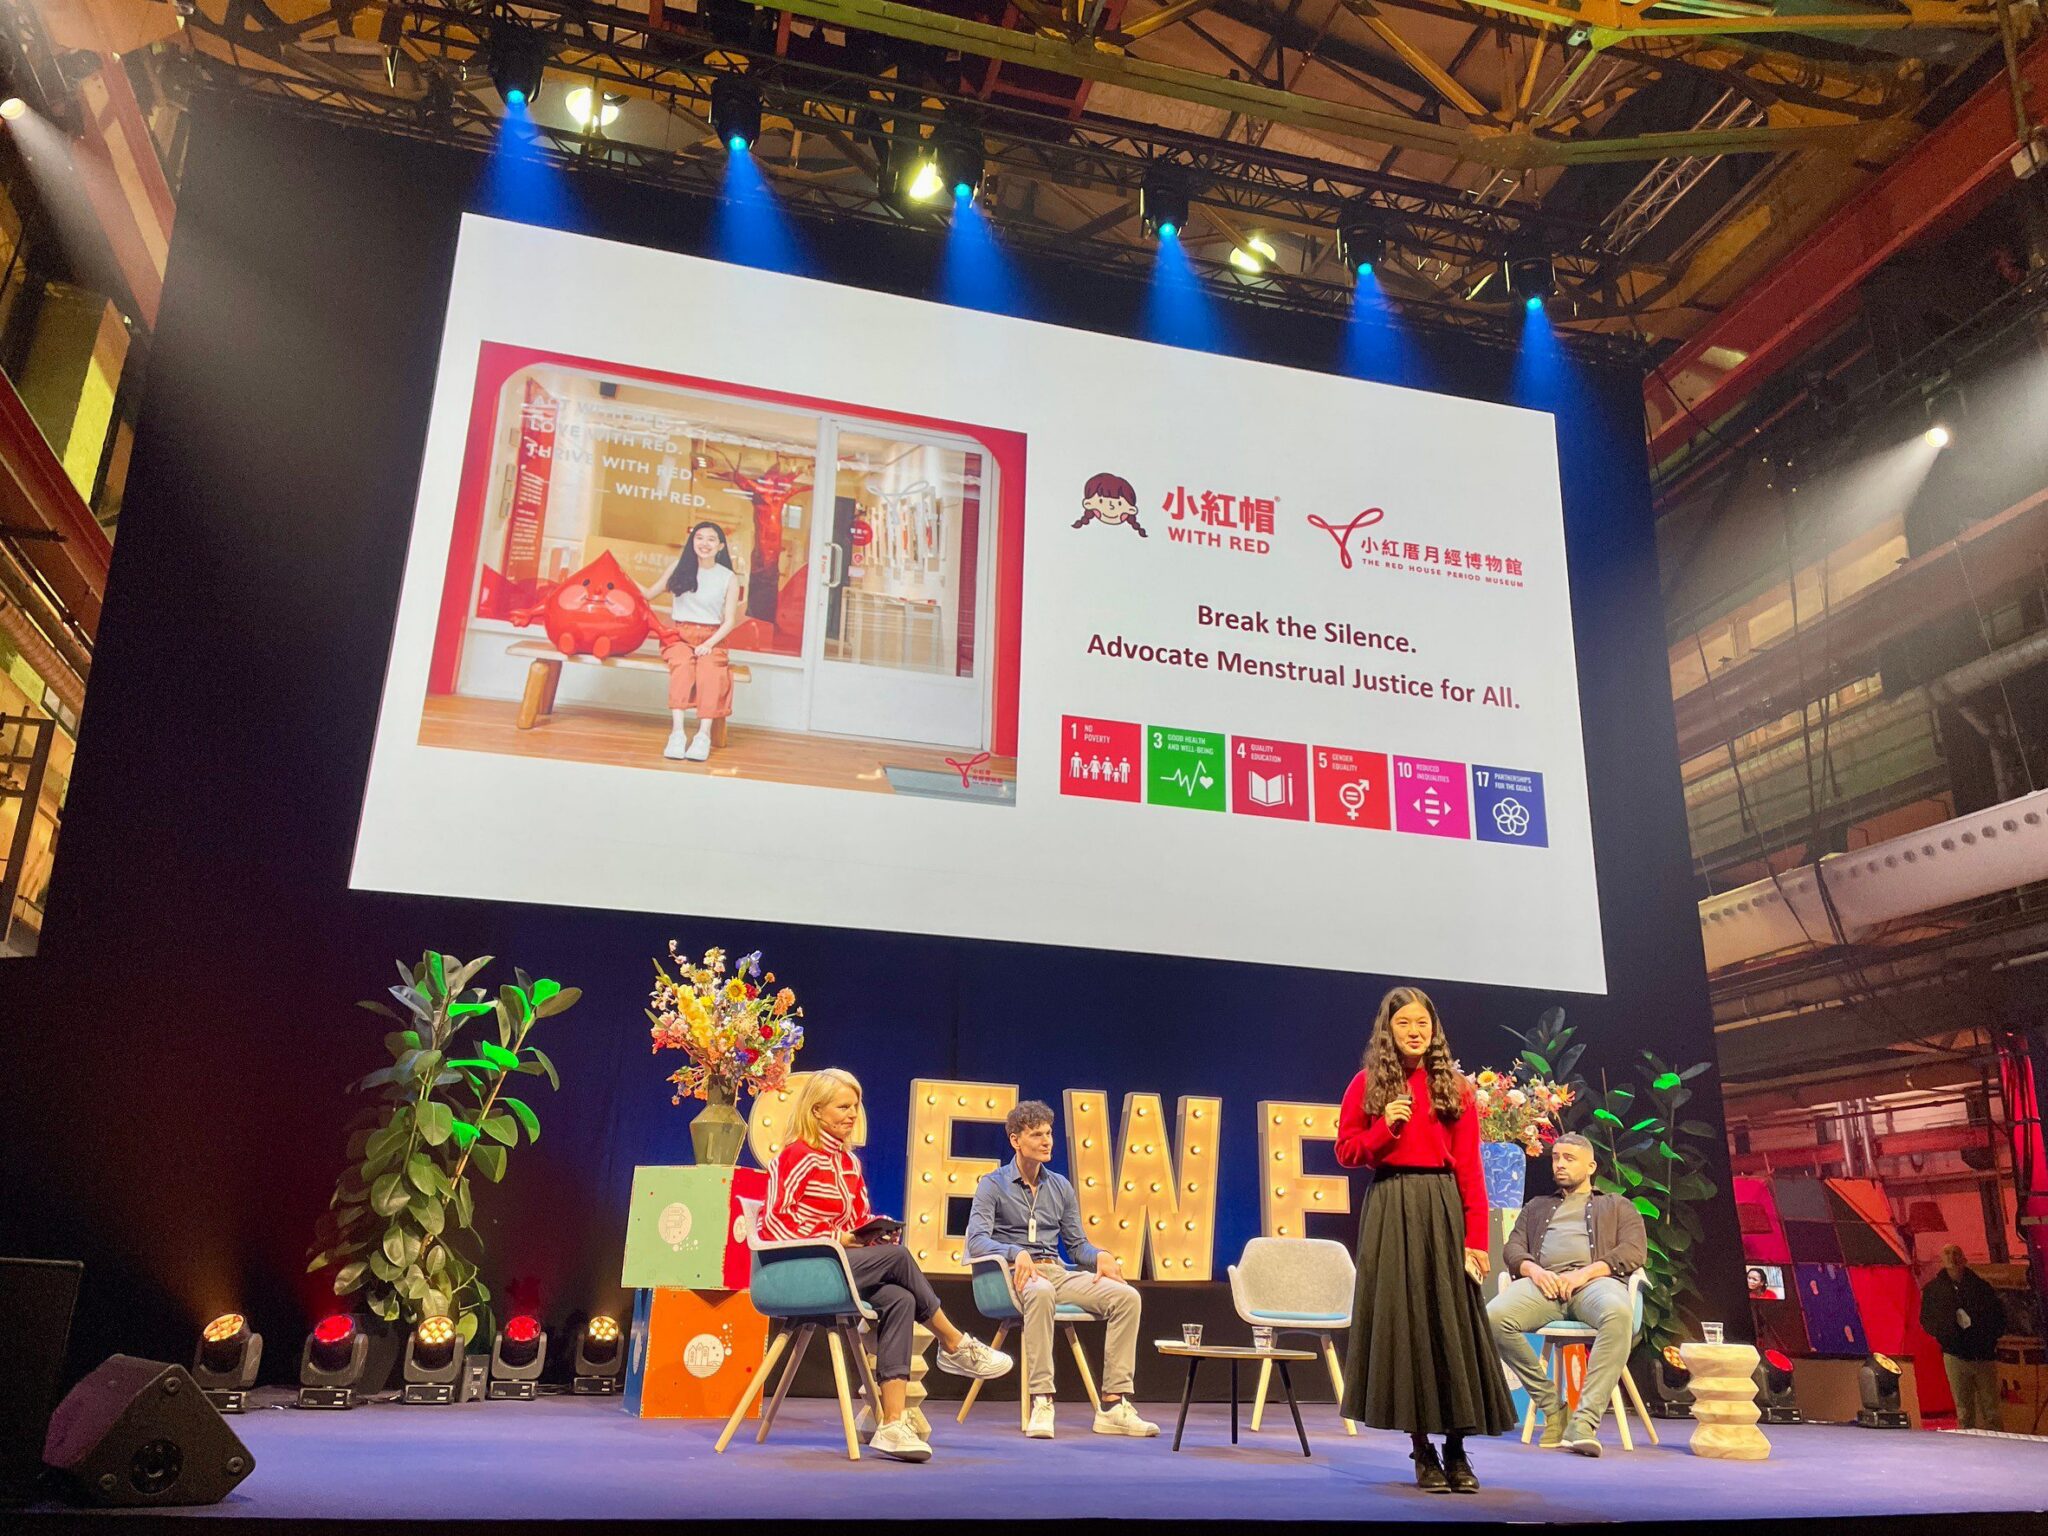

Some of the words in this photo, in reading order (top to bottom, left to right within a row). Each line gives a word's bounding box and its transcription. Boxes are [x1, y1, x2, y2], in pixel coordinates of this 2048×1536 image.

[602, 455, 650, 474] WITH
[615, 482, 664, 502] WITH
[669, 490, 711, 510] RED.
[1168, 526, 1221, 548] WITH
[1229, 536, 1270, 555] RED
[1362, 558, 1380, 567] THE
[1385, 561, 1404, 570] RED
[1408, 565, 1442, 576] HOUSE
[1447, 570, 1481, 582] PERIOD
[1485, 576, 1524, 588] MUSEUM
[1198, 605, 1269, 633] Break
[1276, 616, 1317, 640] the
[1324, 622, 1416, 653] Silence.
[1087, 633, 1209, 668] Advocate
[1217, 650, 1345, 687] Menstrual
[1352, 668, 1434, 698] Justice
[1441, 678, 1475, 703] for
[1482, 686, 1520, 709] All.
[1071, 723, 1077, 740] 1
[1084, 724, 1094, 732] NO
[1083, 733, 1111, 744] POVERTY
[1153, 732, 1163, 749] 3
[1167, 734, 1184, 742] GOOD
[1185, 736, 1206, 745] HEALTH
[1180, 745, 1214, 755] WELL-BEING
[1236, 743, 1247, 759] 4
[1250, 744, 1274, 753] QUALITY
[1251, 753, 1281, 763] EDUCATION
[1318, 752, 1328, 768] 5
[1332, 753, 1353, 763] GENDER
[1332, 763, 1358, 772] EQUALITY
[1397, 762, 1412, 778] 10
[1416, 764, 1440, 773] REDUCED
[1416, 773, 1450, 783] INEQUALITIES
[1475, 771, 1490, 788] 17
[1494, 773, 1532, 784] PARTNERSHIPS
[1495, 782, 1506, 790] FOR
[1506, 783, 1515, 791] THE
[1515, 784, 1532, 793] GOALS
